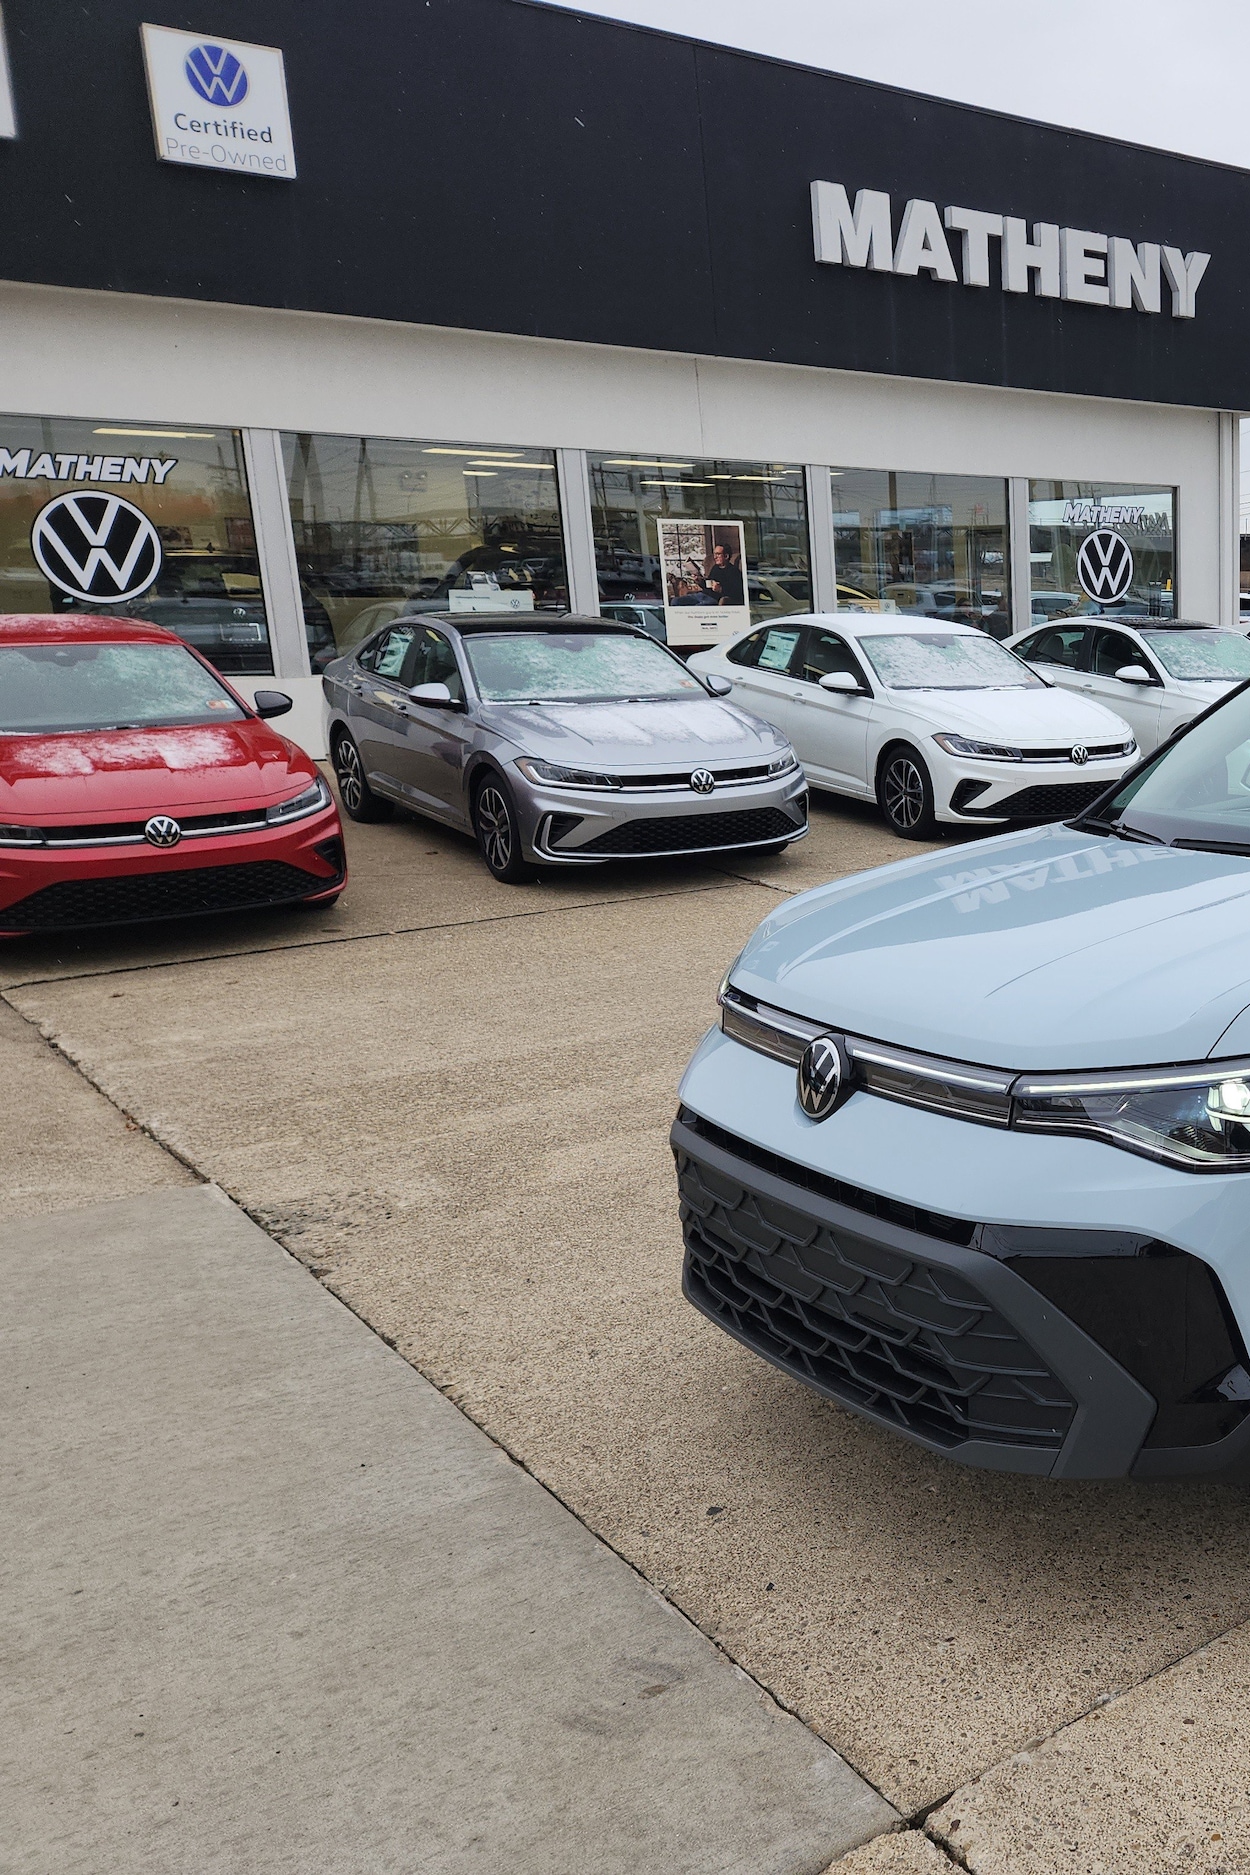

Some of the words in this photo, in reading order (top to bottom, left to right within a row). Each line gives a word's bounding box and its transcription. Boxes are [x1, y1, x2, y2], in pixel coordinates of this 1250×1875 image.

[174, 113, 273, 143] Certified
[166, 137, 287, 172] Pre-Owned
[810, 180, 1212, 319] MATHENY
[0, 447, 178, 484] MATHENY
[1062, 503, 1145, 524] MATHENY
